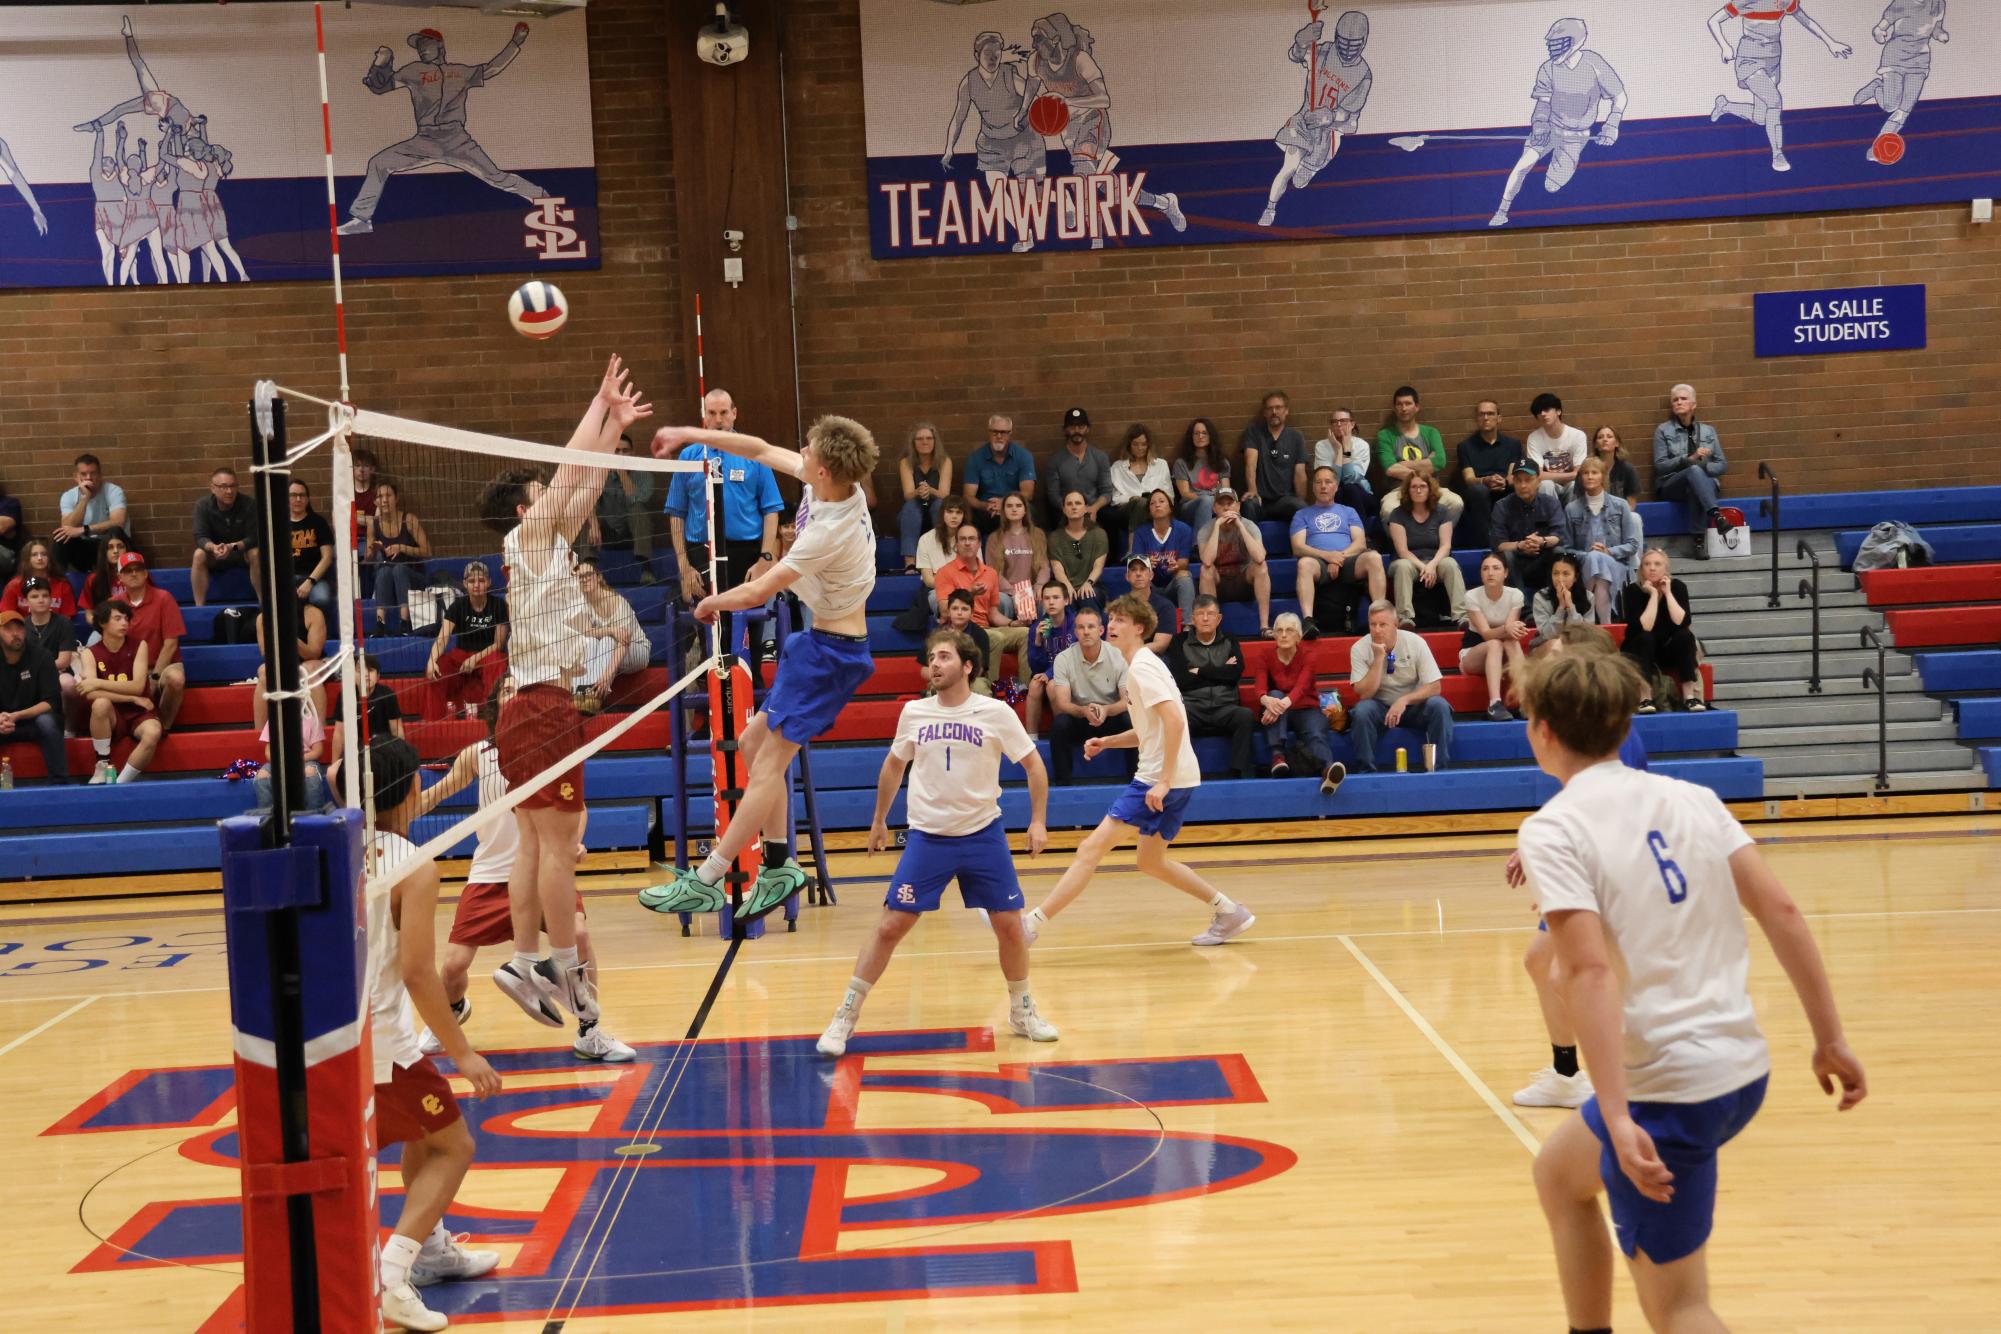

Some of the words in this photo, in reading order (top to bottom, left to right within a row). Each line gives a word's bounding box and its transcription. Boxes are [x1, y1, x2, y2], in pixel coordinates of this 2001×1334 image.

[880, 172, 1151, 247] TEAMWORK
[1800, 302, 1824, 320] LA
[1829, 299, 1883, 318] SALLE
[1794, 321, 1890, 343] STUDENTS
[917, 722, 983, 747] FALCONS
[946, 745, 951, 771] 1
[1647, 829, 1687, 904] 6
